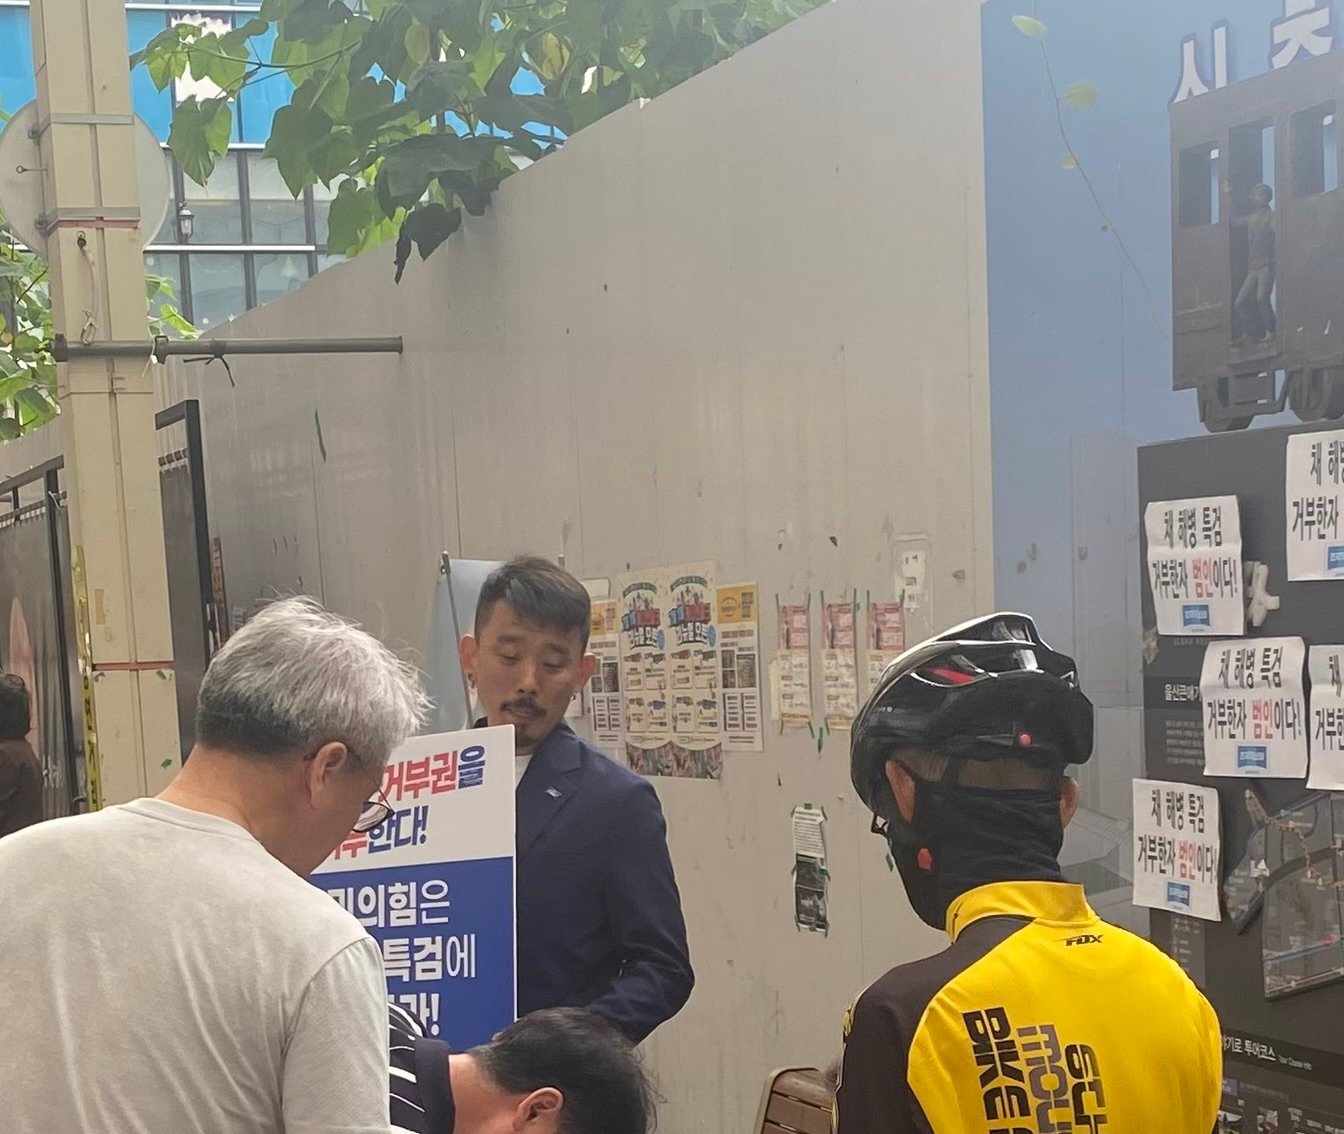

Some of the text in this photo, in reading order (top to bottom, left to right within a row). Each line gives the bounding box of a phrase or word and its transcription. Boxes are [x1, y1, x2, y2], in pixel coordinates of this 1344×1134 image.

[1310, 441, 1322, 486] 채
[1164, 505, 1222, 549] 채 해병 특검
[1292, 495, 1339, 541] 거부한자
[1152, 557, 1237, 599] 거부한자 범인이다!
[1218, 646, 1283, 689] 채 해병 특검
[1328, 654, 1342, 697] 채
[1207, 698, 1302, 740] 거부한자 범인이다!
[378, 745, 486, 802] 거부권을
[1151, 789, 1205, 833] 채 해병 특검
[1138, 834, 1176, 876] 거부한자
[962, 1006, 1032, 1121] BIKE
[1244, 1039, 1276, 1061] 투어코스
